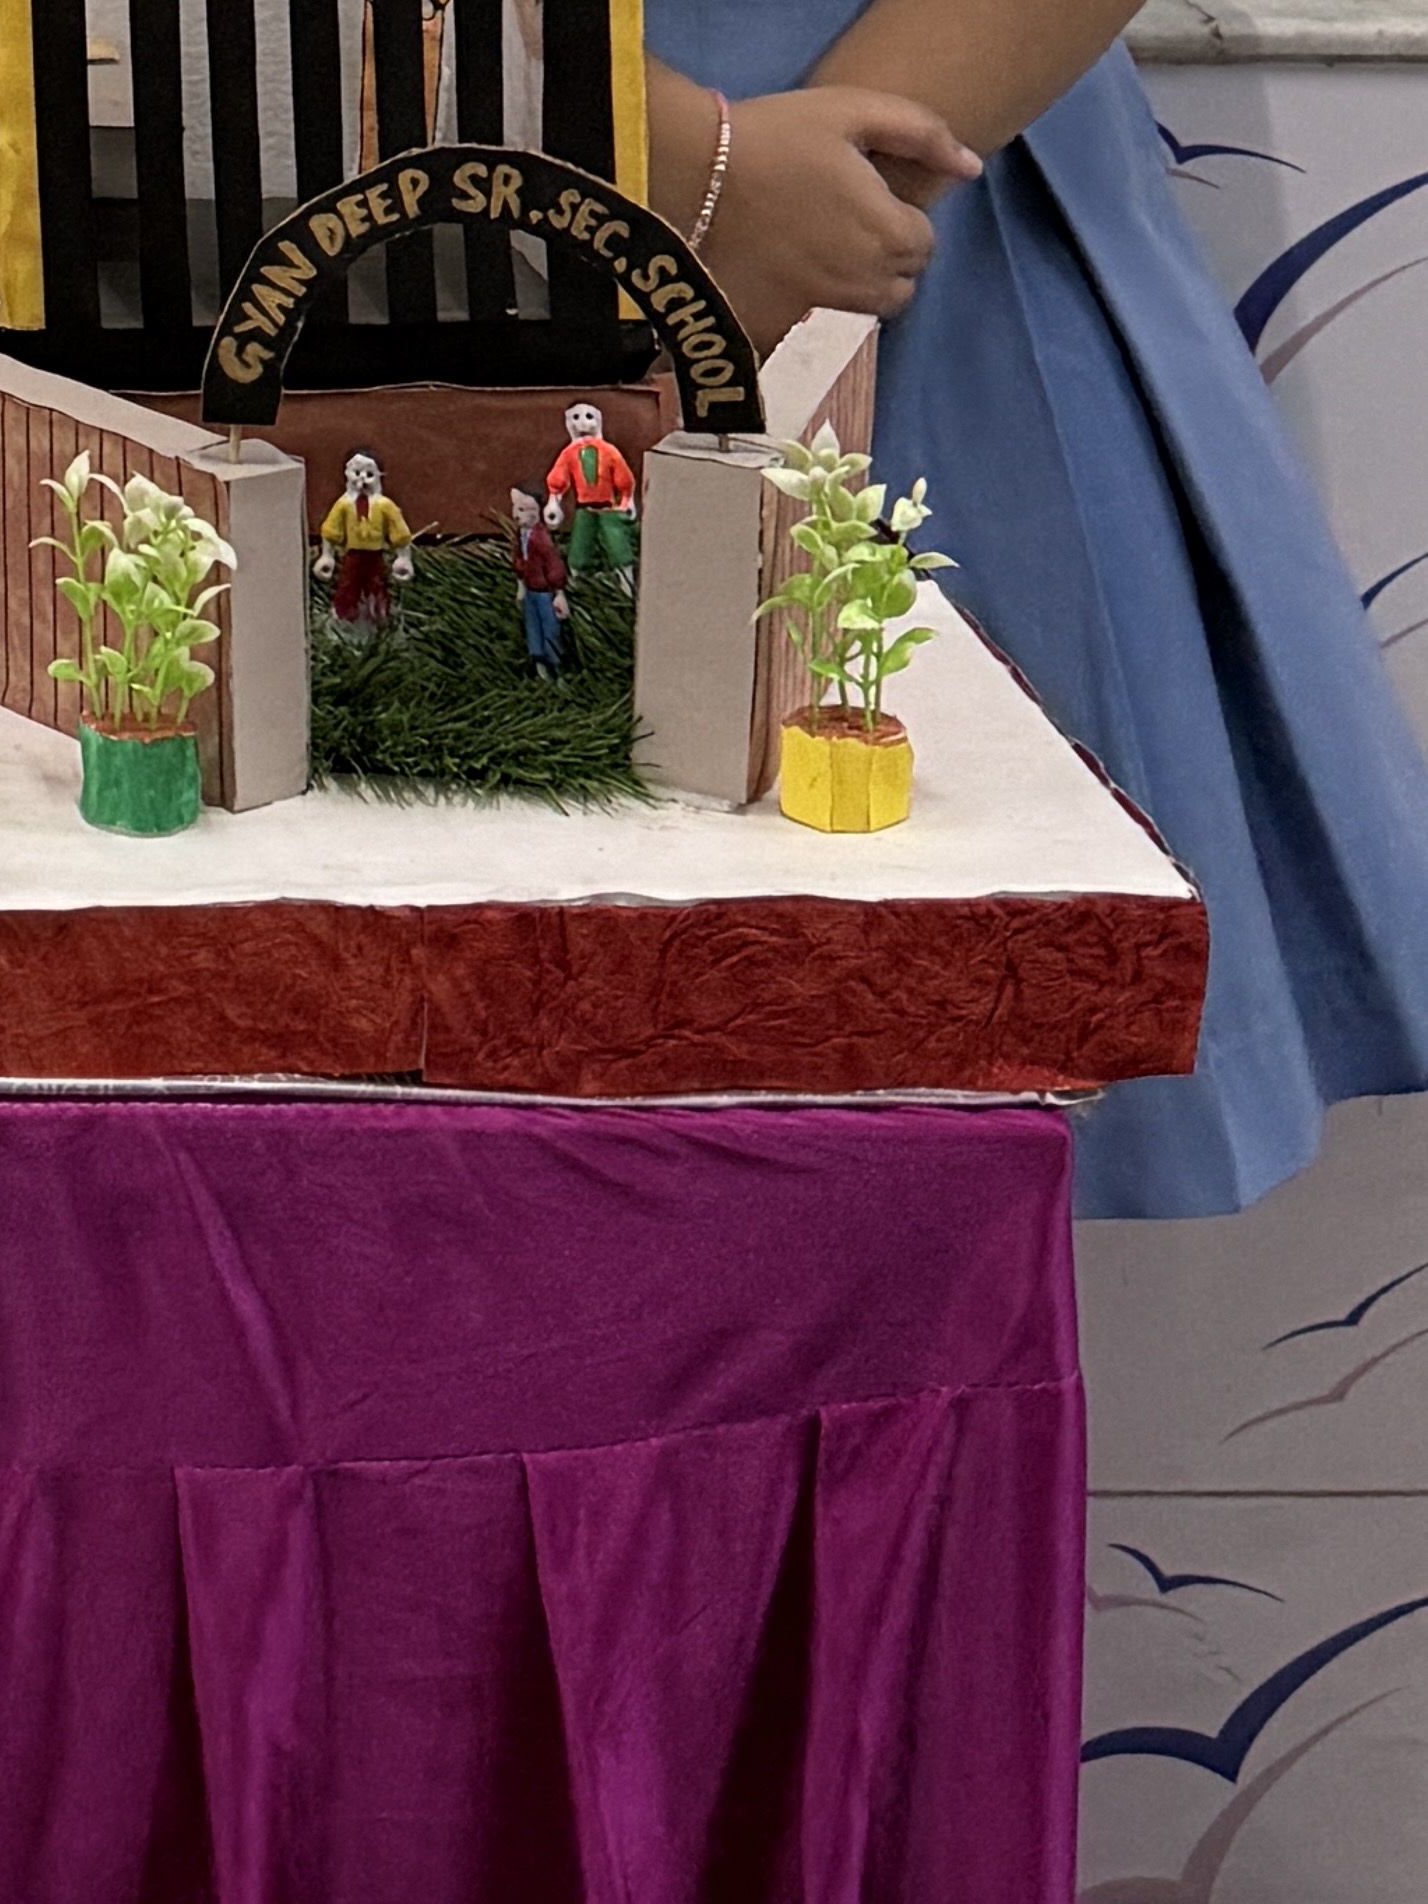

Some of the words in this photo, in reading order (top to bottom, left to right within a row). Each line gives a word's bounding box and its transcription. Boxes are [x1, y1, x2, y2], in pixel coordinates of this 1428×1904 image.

[217, 240, 318, 384] GYAN
[308, 167, 430, 257] DEEP
[631, 253, 745, 418] SCHOOL
